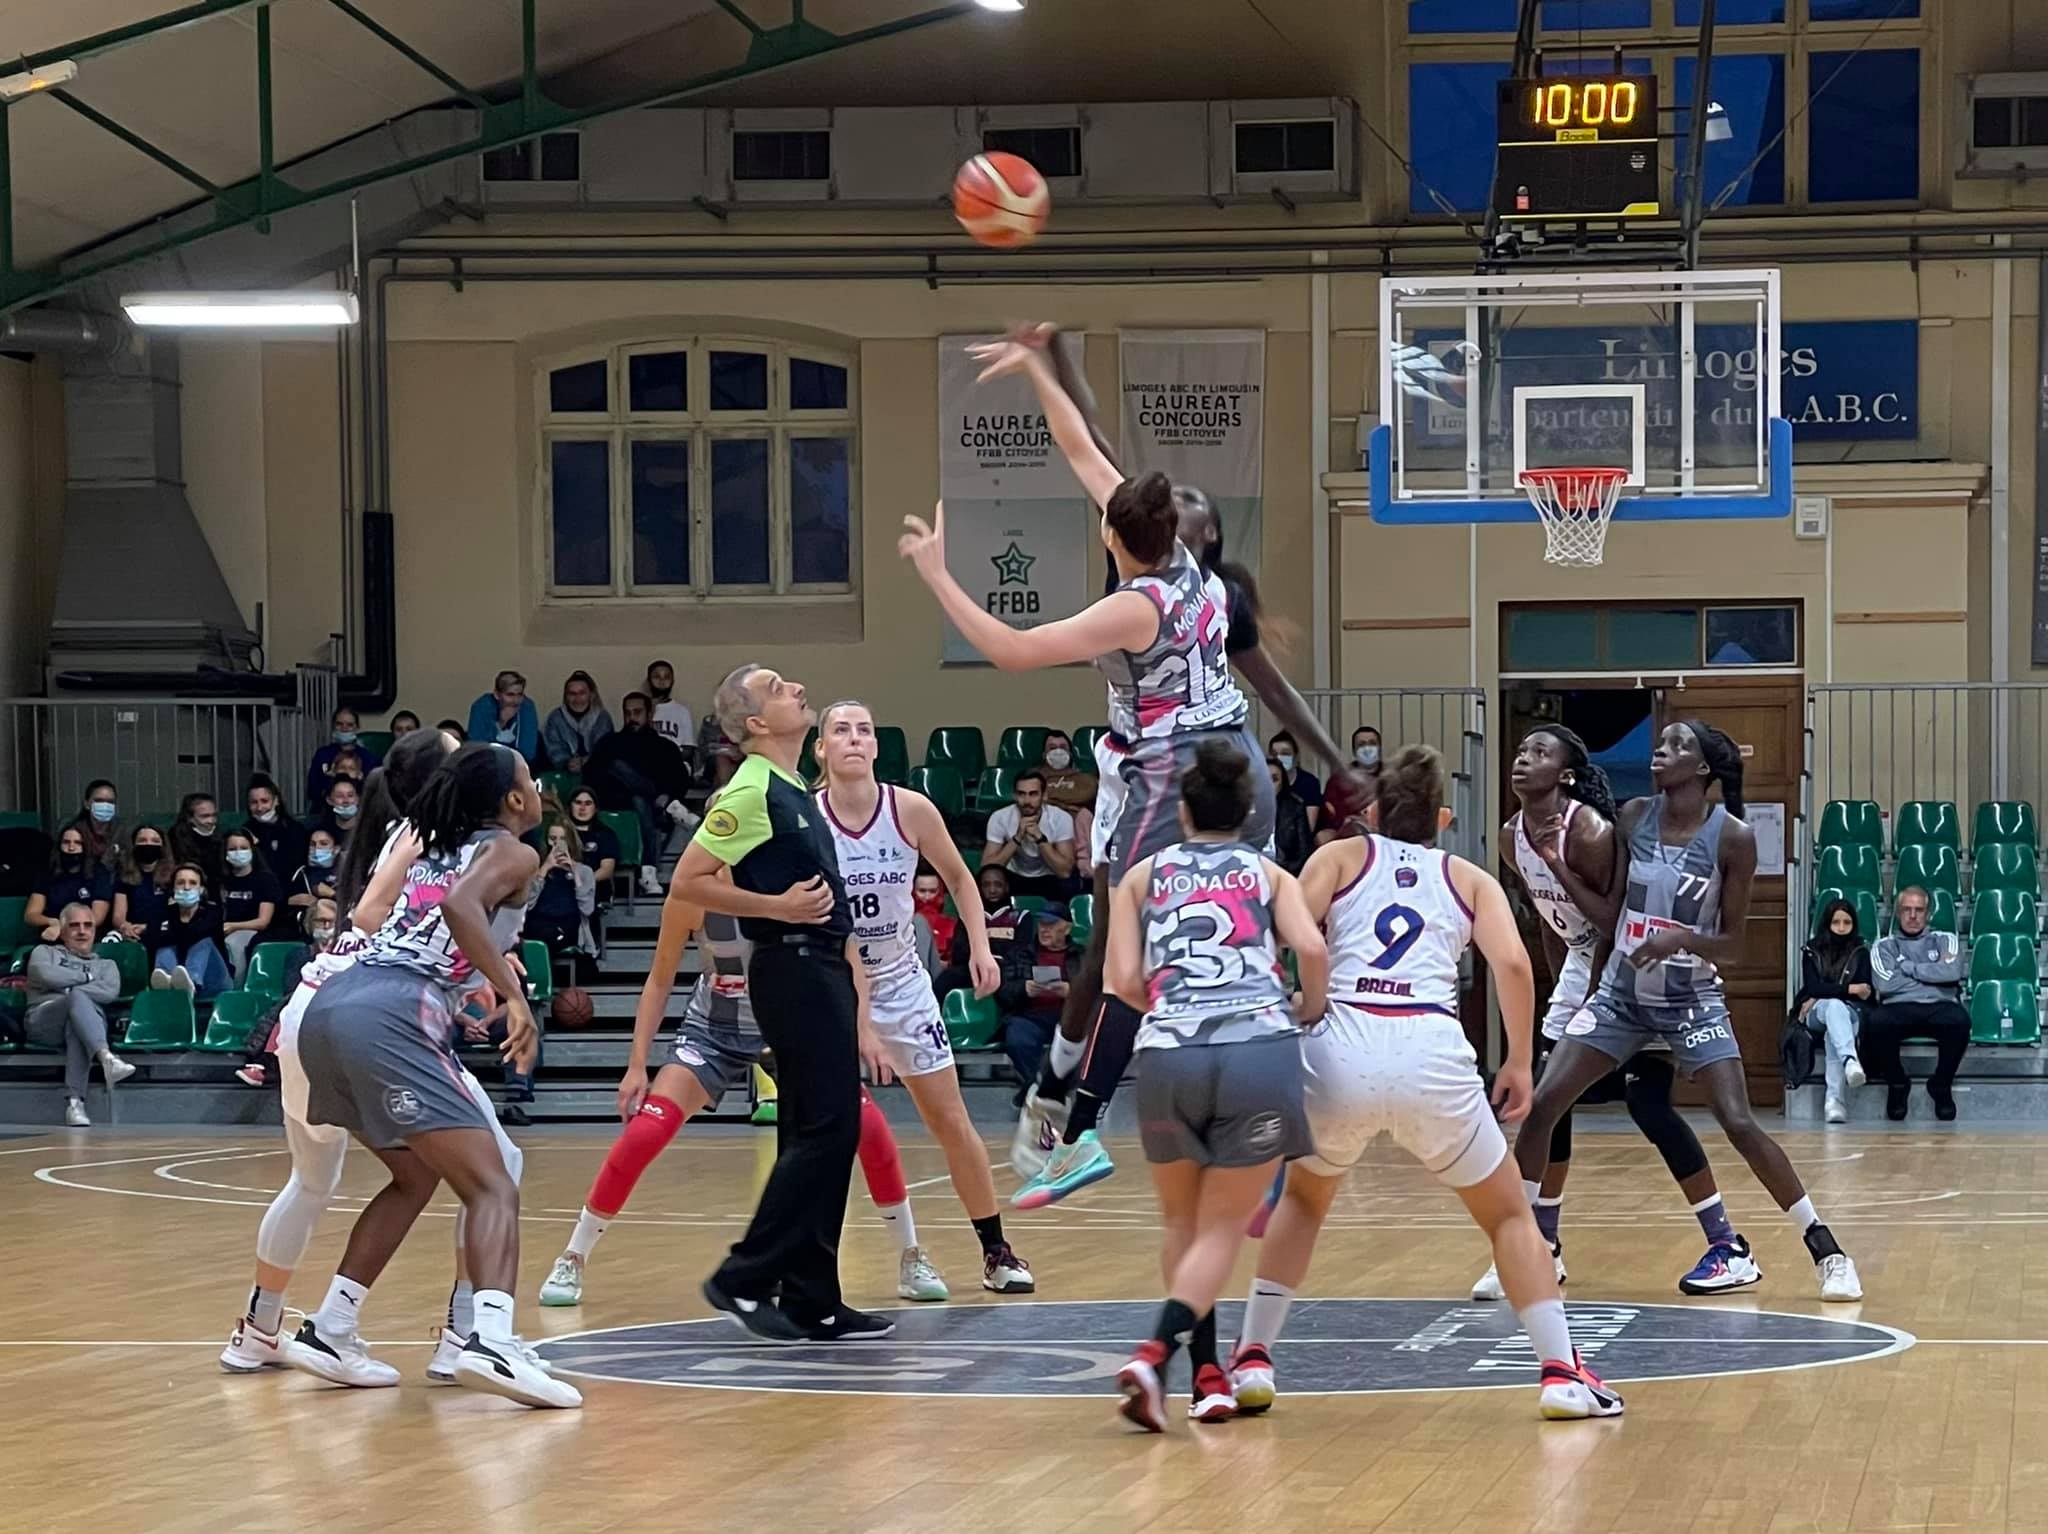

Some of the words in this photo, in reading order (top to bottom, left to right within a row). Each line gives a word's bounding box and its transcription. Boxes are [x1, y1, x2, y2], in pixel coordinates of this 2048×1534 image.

[1535, 82, 1637, 125] 10:00
[1122, 384, 1167, 393] LIMOGES
[1192, 384, 1207, 393] EN
[1209, 384, 1260, 393] LIMOUSIN
[1141, 395, 1241, 410] LAUREAT
[963, 415, 1047, 430] LAUREA
[1139, 411, 1242, 427] CONCOURS
[960, 432, 1057, 447] CONCOUR
[1154, 429, 1180, 438] FFBB
[1182, 429, 1227, 438] CITOYEN
[987, 590, 1041, 615] FFBB
[878, 872, 907, 885] ABC
[1153, 868, 1257, 898] MONACO
[1676, 871, 1711, 902] 77
[849, 893, 880, 919] 18
[1552, 908, 1568, 930] 6
[1176, 898, 1246, 990] 3
[1367, 902, 1426, 971] 9
[1355, 976, 1416, 998] BREUIL
[924, 1020, 949, 1050] 18
